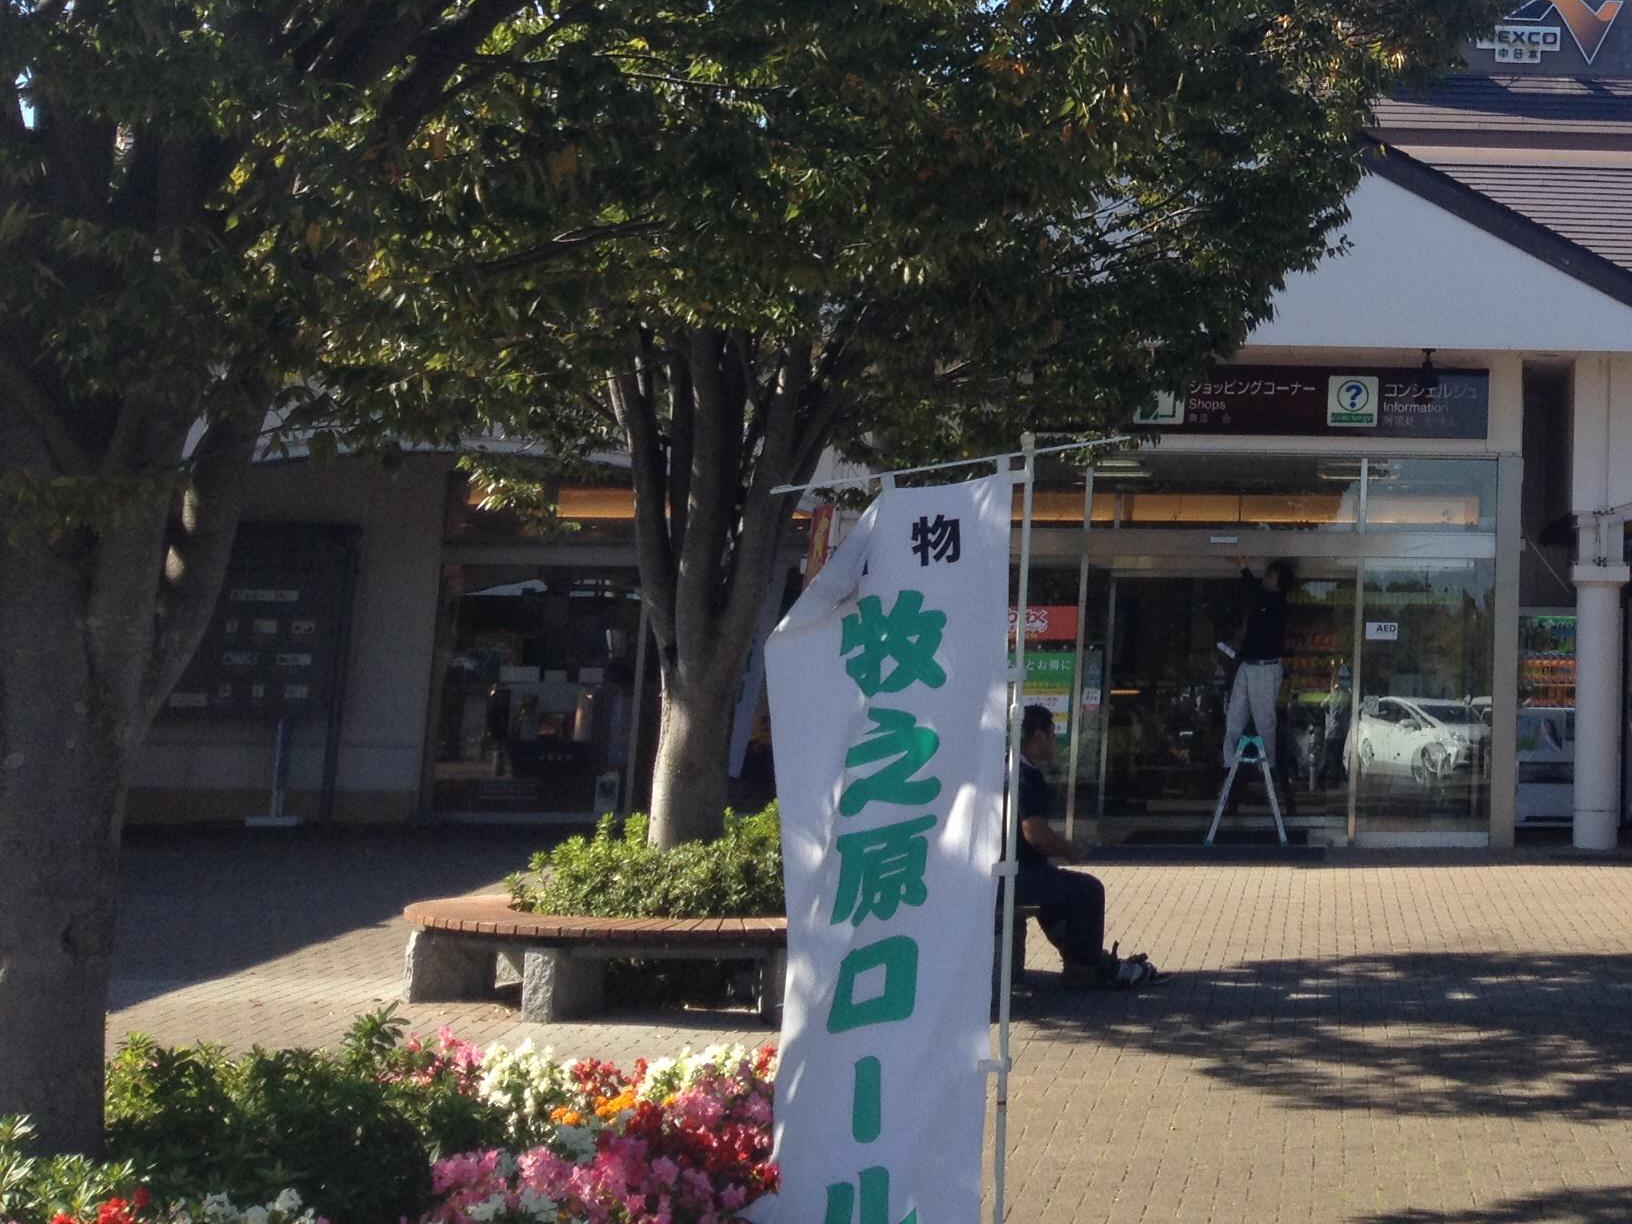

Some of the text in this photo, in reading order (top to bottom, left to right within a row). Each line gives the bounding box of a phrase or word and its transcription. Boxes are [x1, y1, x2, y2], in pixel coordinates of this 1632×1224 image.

[1480, 30, 1558, 45] EXCO
[1498, 48, 1538, 59] 中日本
[1189, 380, 1316, 396] ショッピングコーナー
[1188, 398, 1226, 412] Shops
[1383, 402, 1449, 413] Information
[911, 514, 961, 567] 物
[1376, 624, 1397, 633] AED
